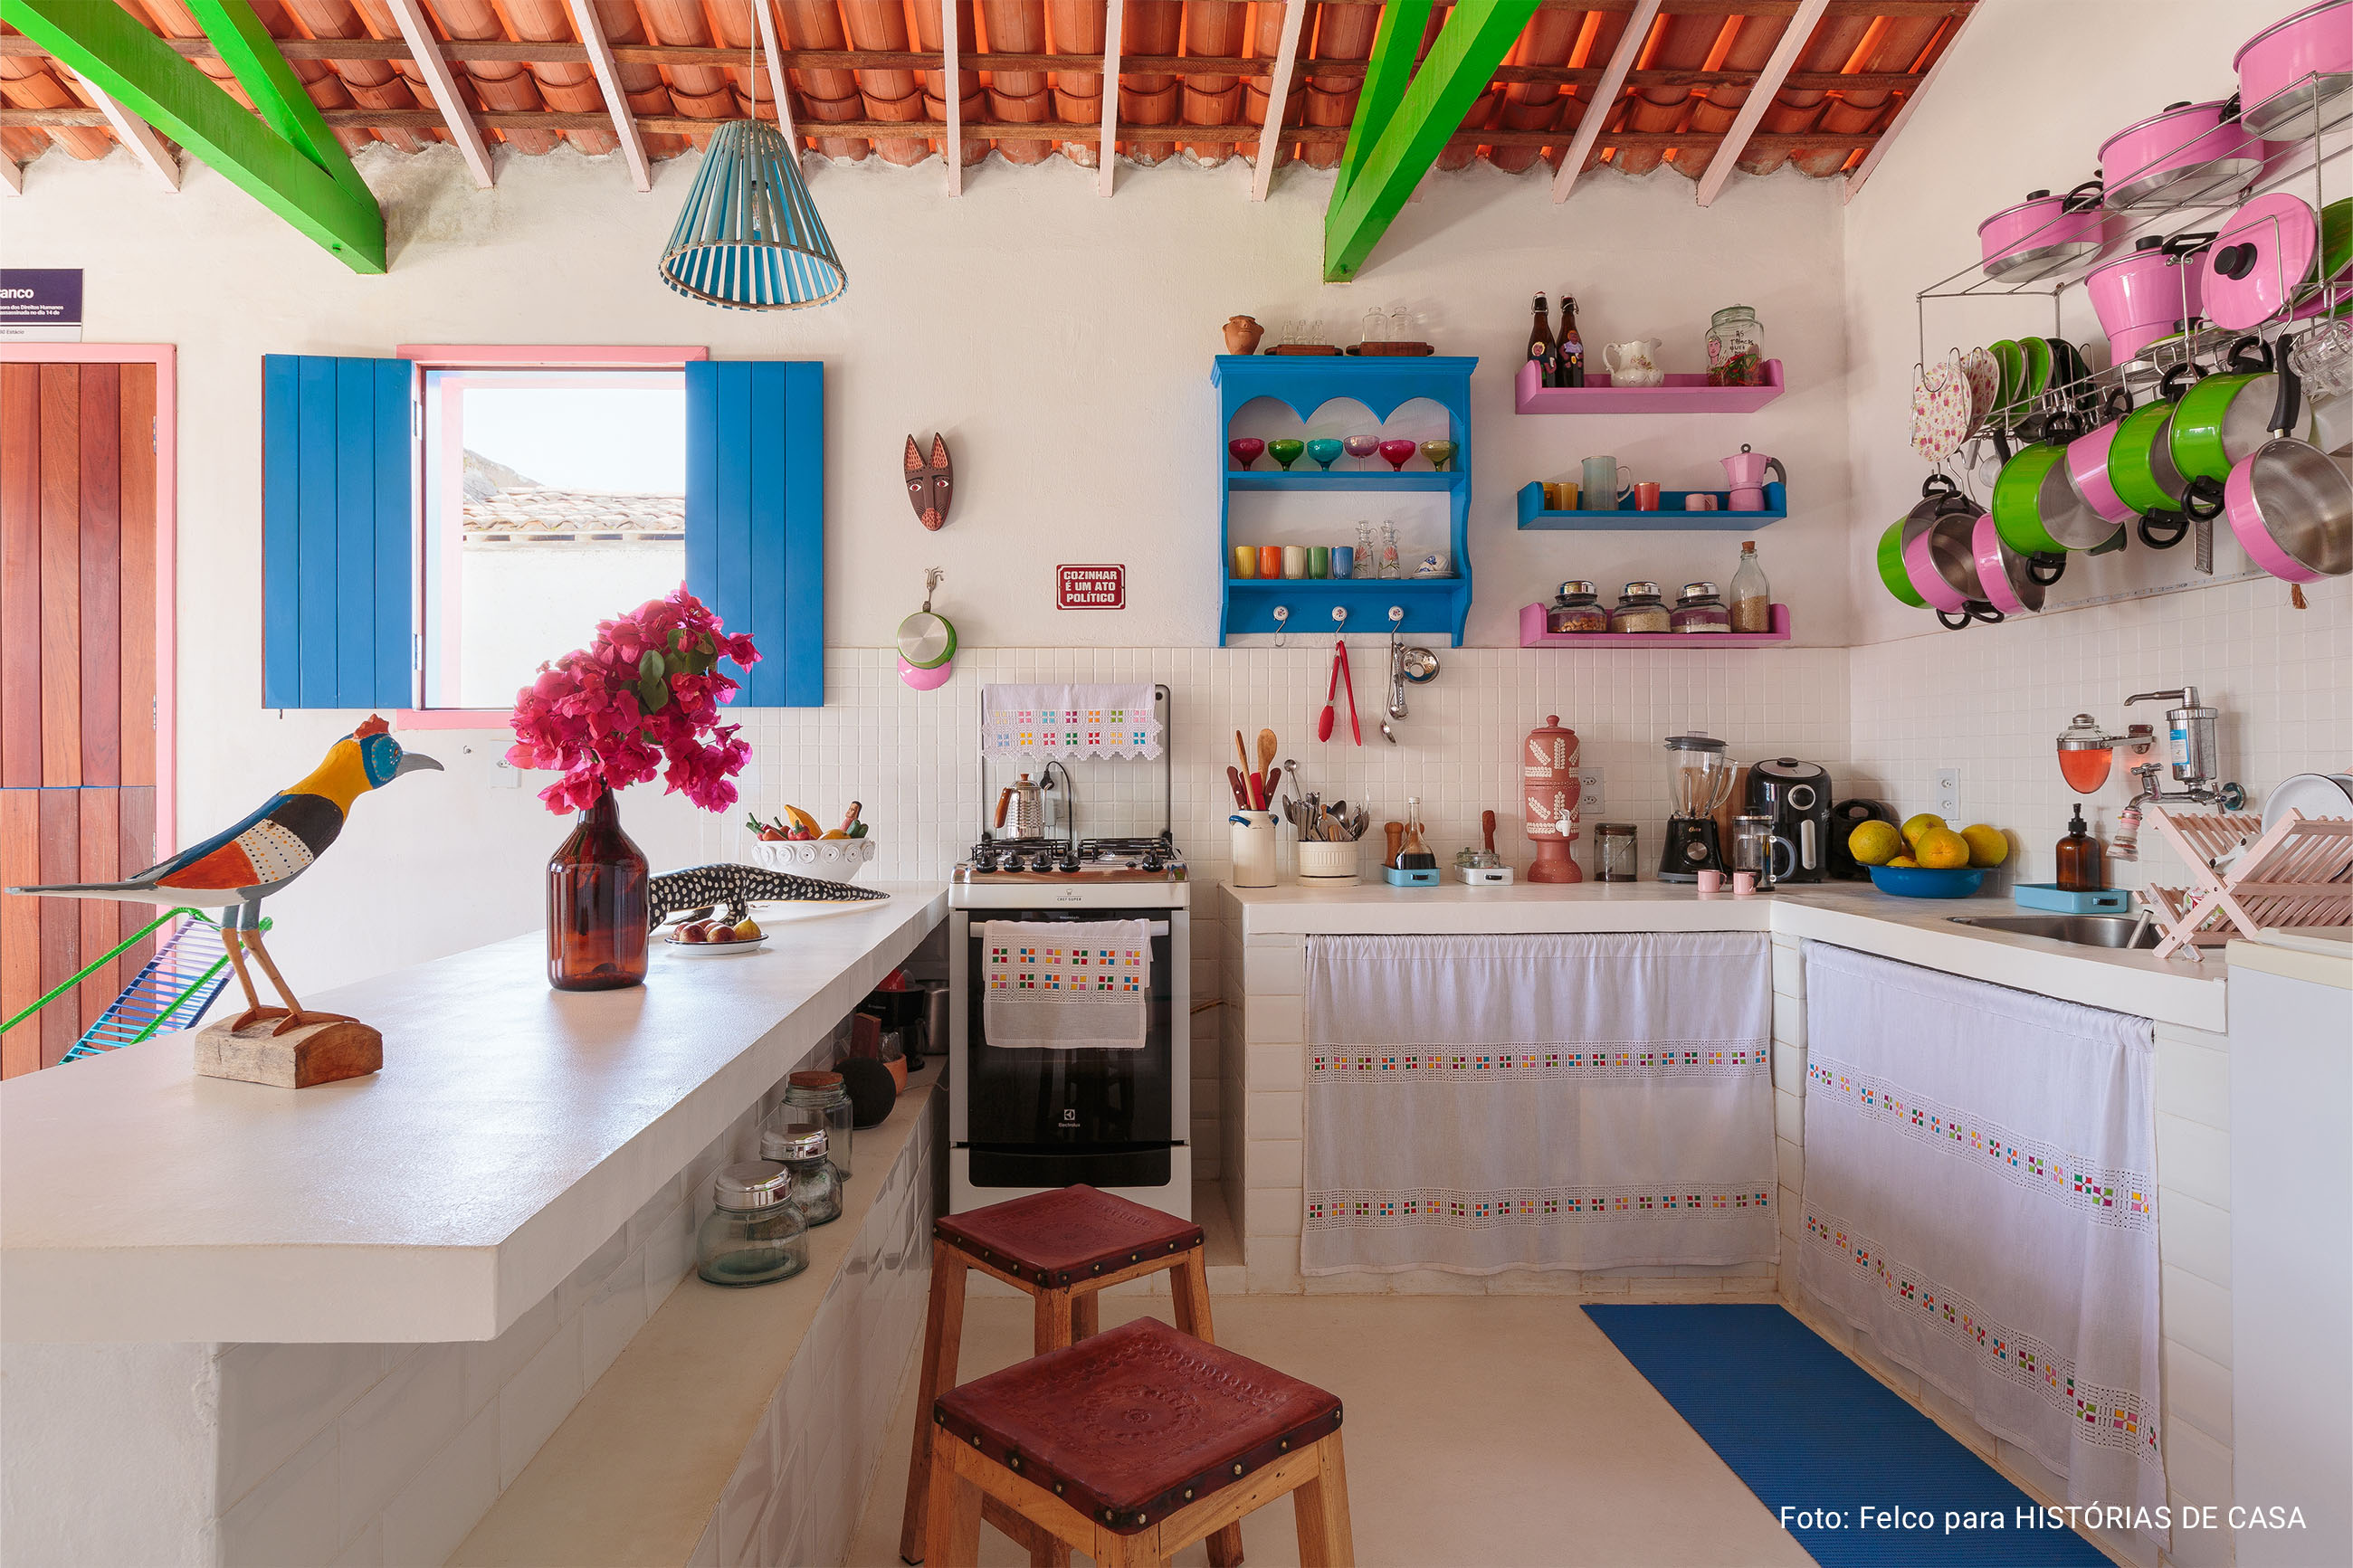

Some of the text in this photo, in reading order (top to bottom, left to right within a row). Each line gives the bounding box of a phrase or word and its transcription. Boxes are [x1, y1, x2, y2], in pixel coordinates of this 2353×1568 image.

[1063, 570, 1117, 580] COZINHAR
[1065, 580, 1116, 591] É UM ATO
[1066, 591, 1115, 603] POLÍTICO
